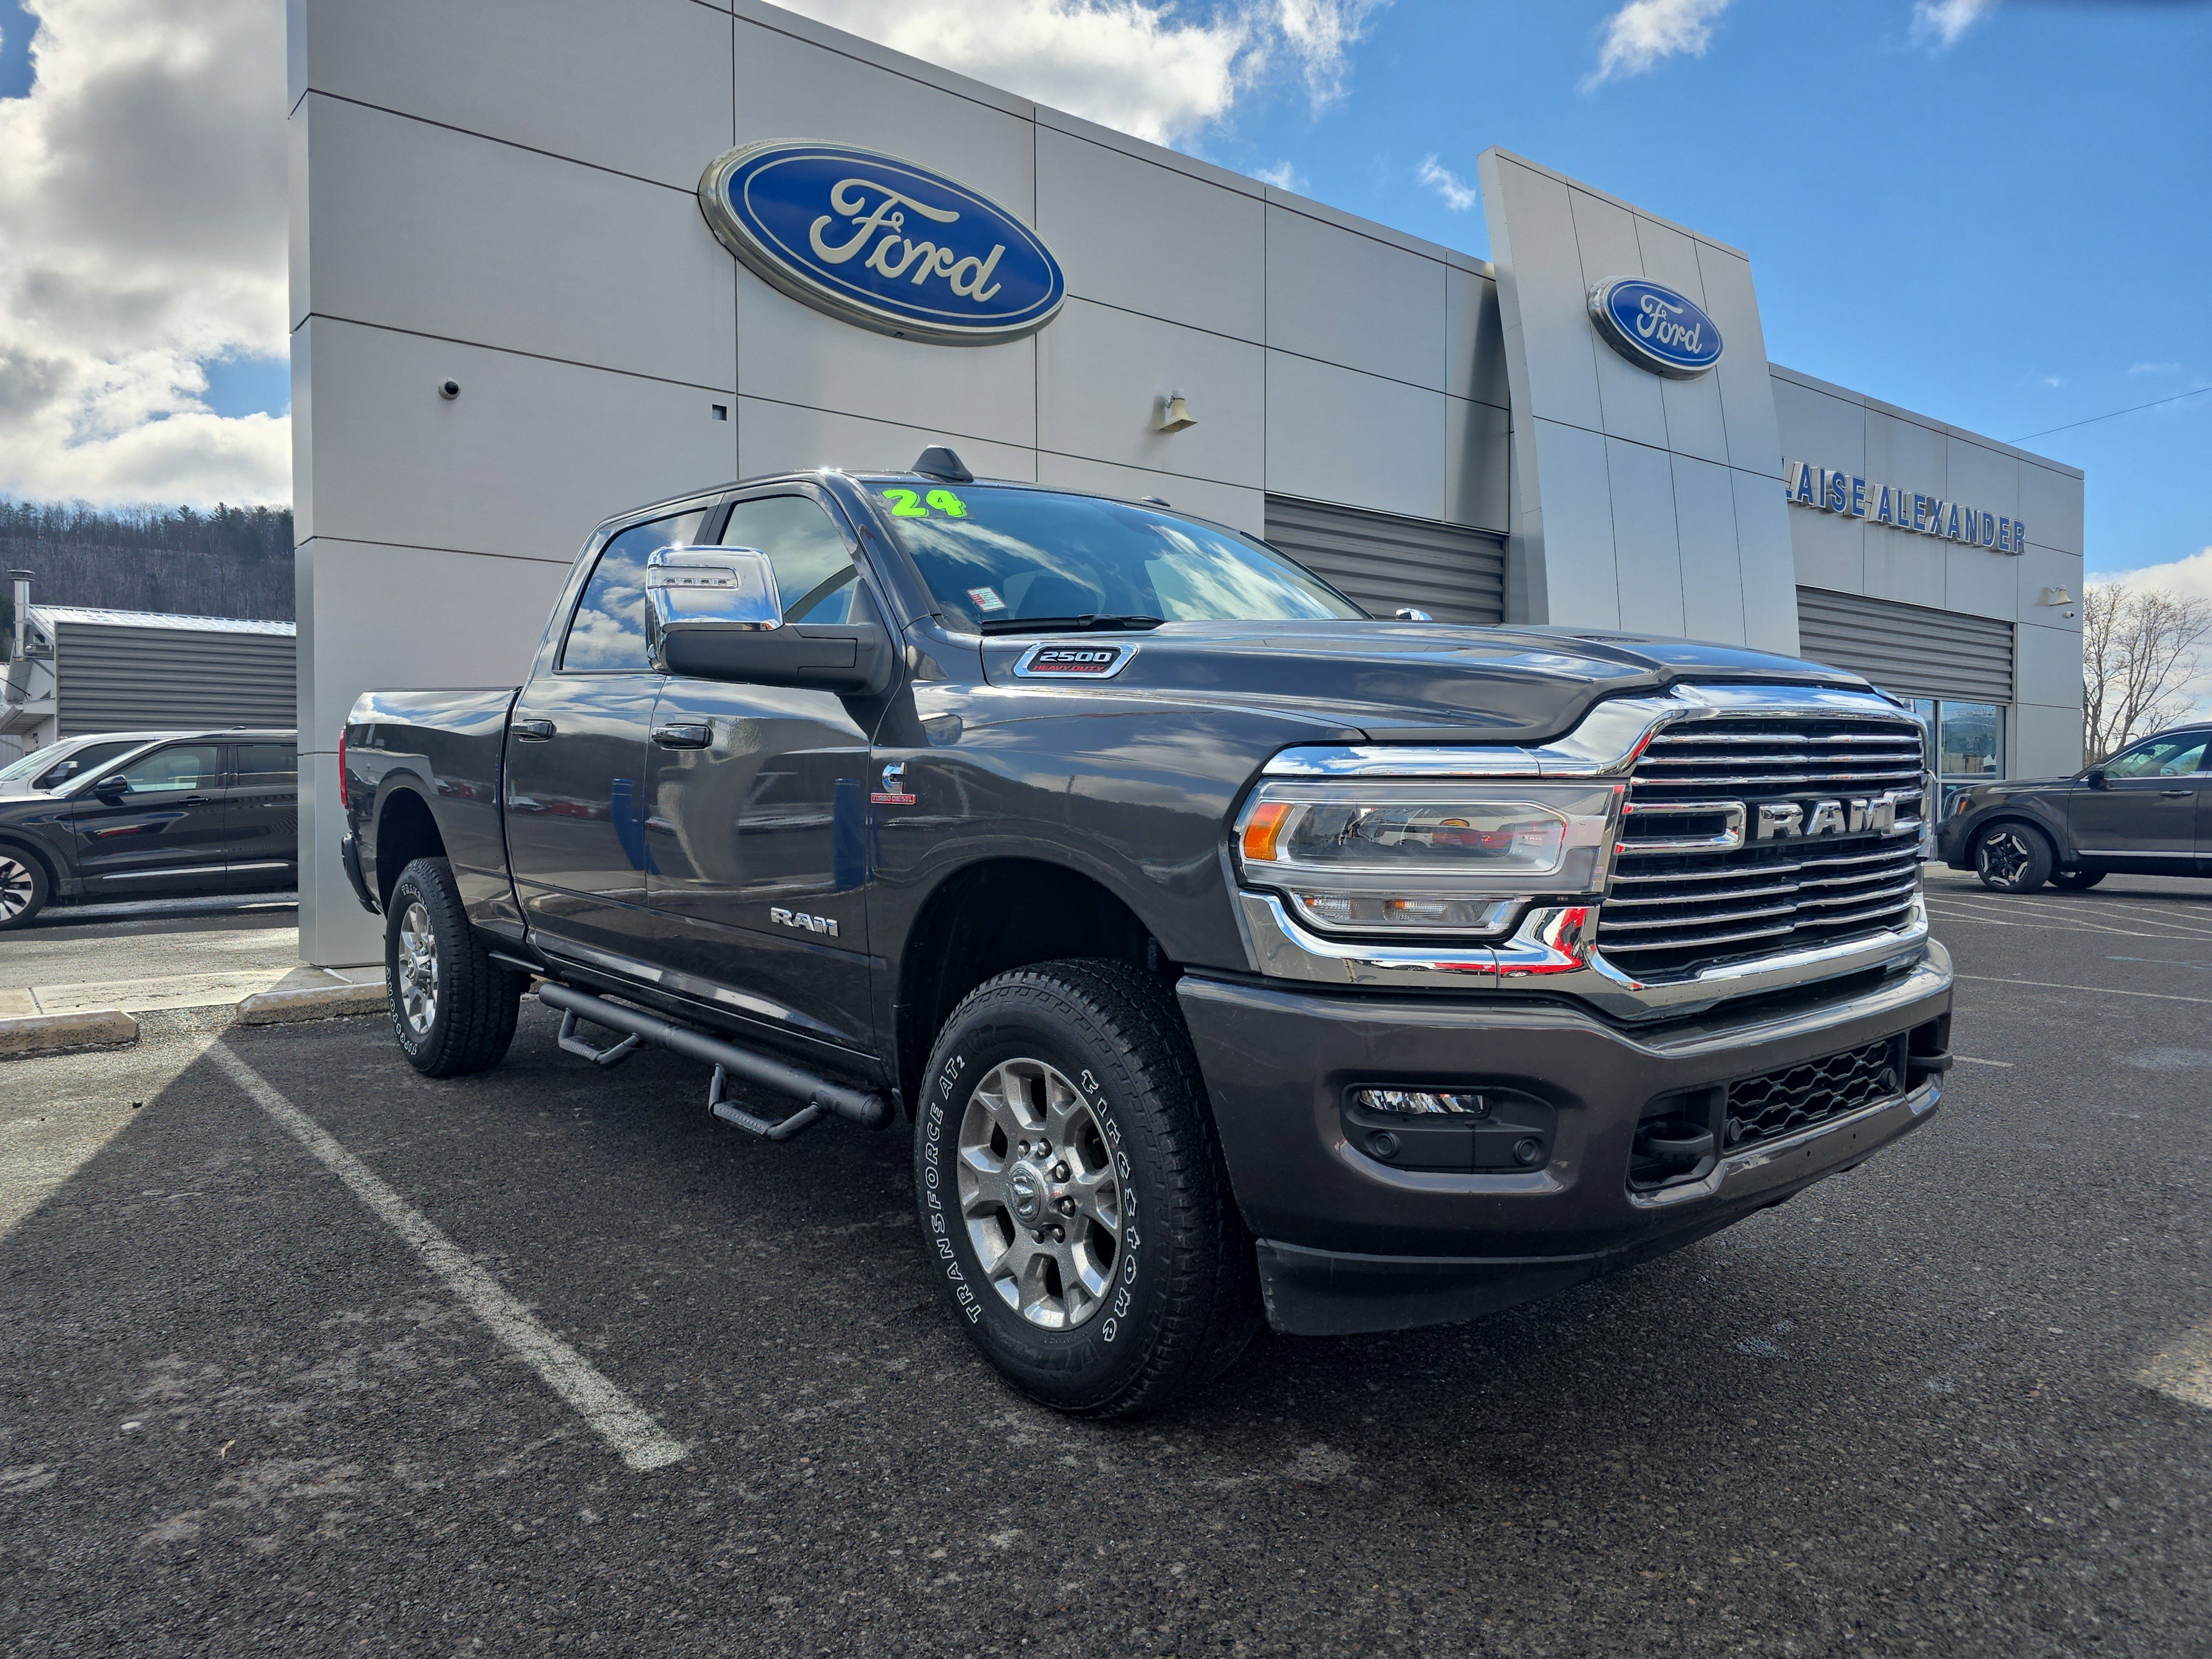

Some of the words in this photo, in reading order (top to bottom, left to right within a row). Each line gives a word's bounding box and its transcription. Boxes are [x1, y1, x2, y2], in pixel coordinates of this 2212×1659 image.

[809, 178, 1006, 303] Ford
[1636, 294, 1702, 354] Ford
[882, 489, 968, 518] 24
[1782, 456, 1867, 518] AISE
[1875, 484, 2026, 556] ALEXANDER
[1039, 651, 1112, 663] 2500
[1757, 798, 1893, 840] RAM
[770, 906, 839, 937] RAM
[923, 1102, 983, 1324] TRANSFORCE
[1081, 1070, 1141, 1342] Firestone
